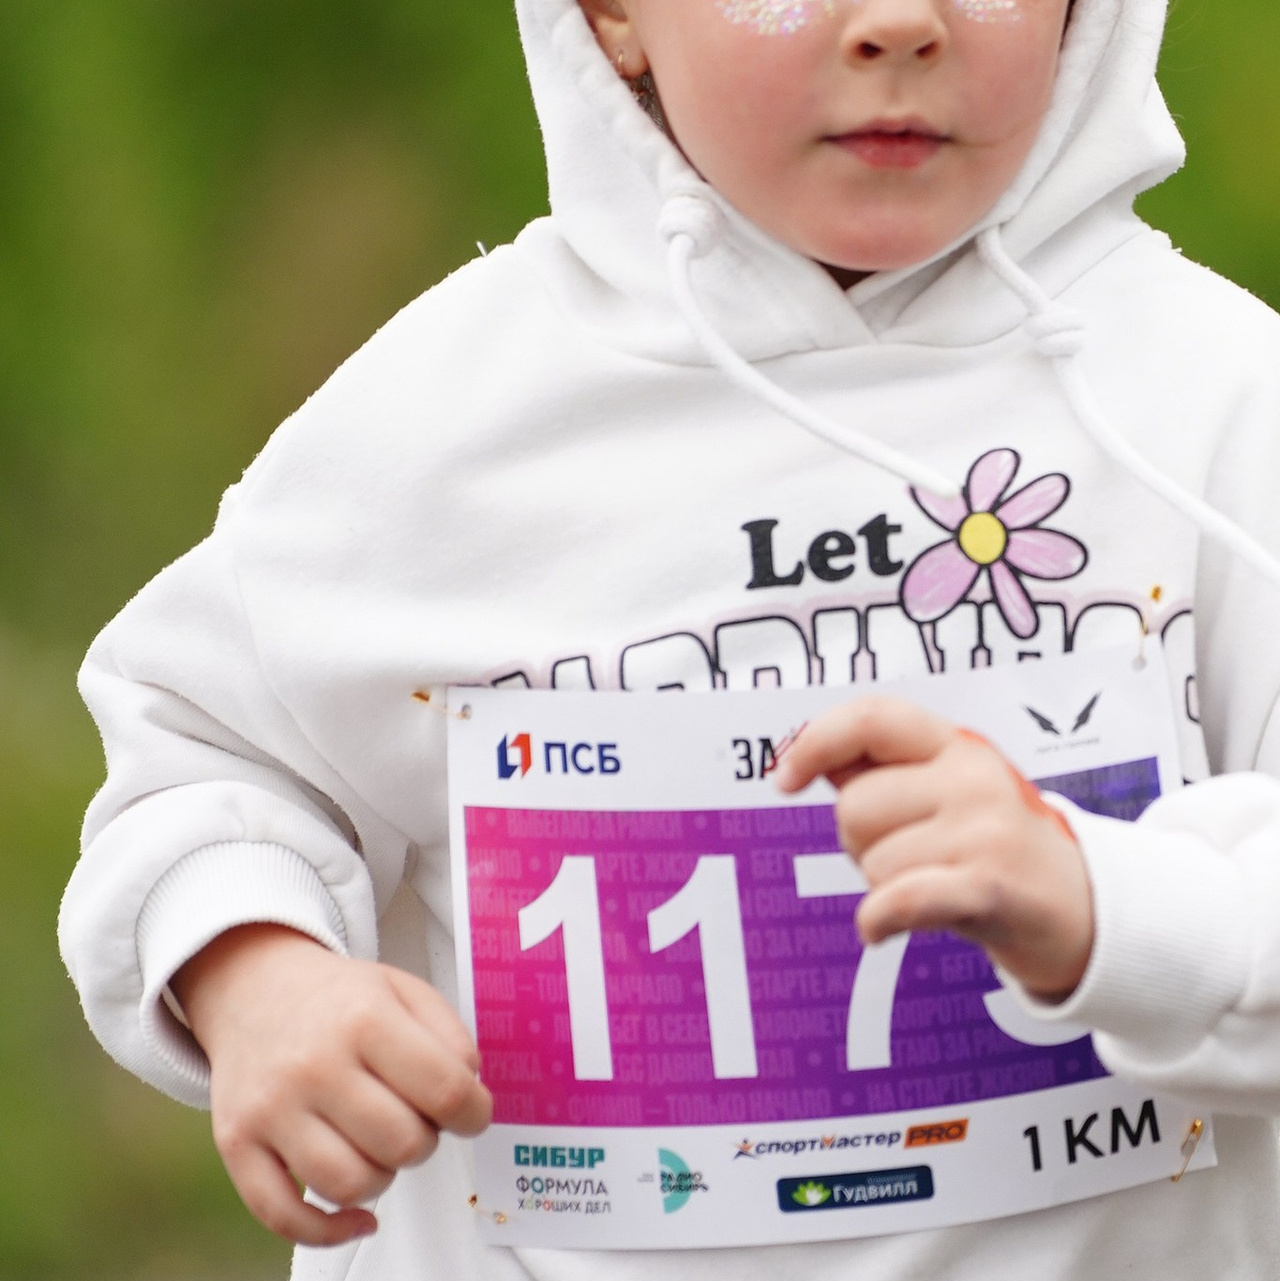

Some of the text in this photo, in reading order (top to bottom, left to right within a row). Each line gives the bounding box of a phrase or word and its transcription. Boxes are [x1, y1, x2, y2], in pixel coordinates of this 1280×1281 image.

[740, 513, 904, 589] Let
[543, 741, 621, 774] ПСБ
[516, 853, 1096, 1082] 117
[1023, 1099, 1161, 1172] 1 КМ
[514, 1145, 605, 1168] СИБУР
[515, 1175, 609, 1196] ФОРМУЛА
[517, 1198, 612, 1214] ХОРОШИХ ДЕЛ
